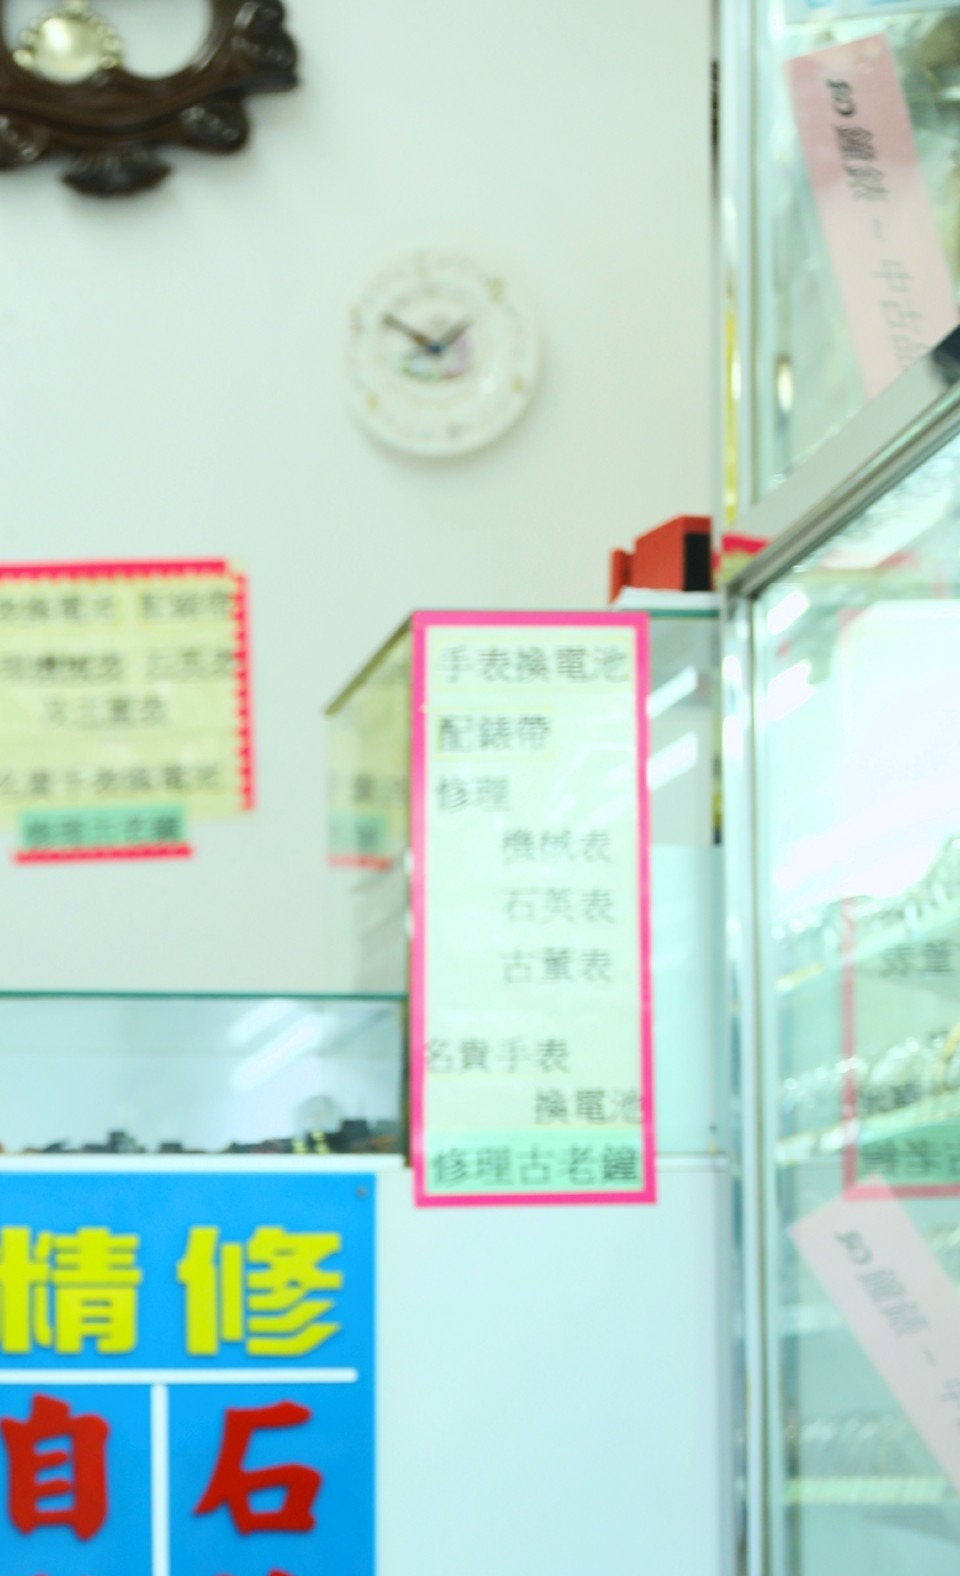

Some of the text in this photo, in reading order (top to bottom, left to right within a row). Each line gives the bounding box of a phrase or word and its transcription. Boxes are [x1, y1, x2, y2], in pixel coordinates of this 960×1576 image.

[441, 645, 629, 684] 手表換電池
[437, 776, 509, 813] 修理
[499, 885, 615, 924] 石英表
[499, 945, 614, 984] 古董表
[426, 1036, 571, 1074] 名貴手表
[534, 1087, 643, 1126] 換電池
